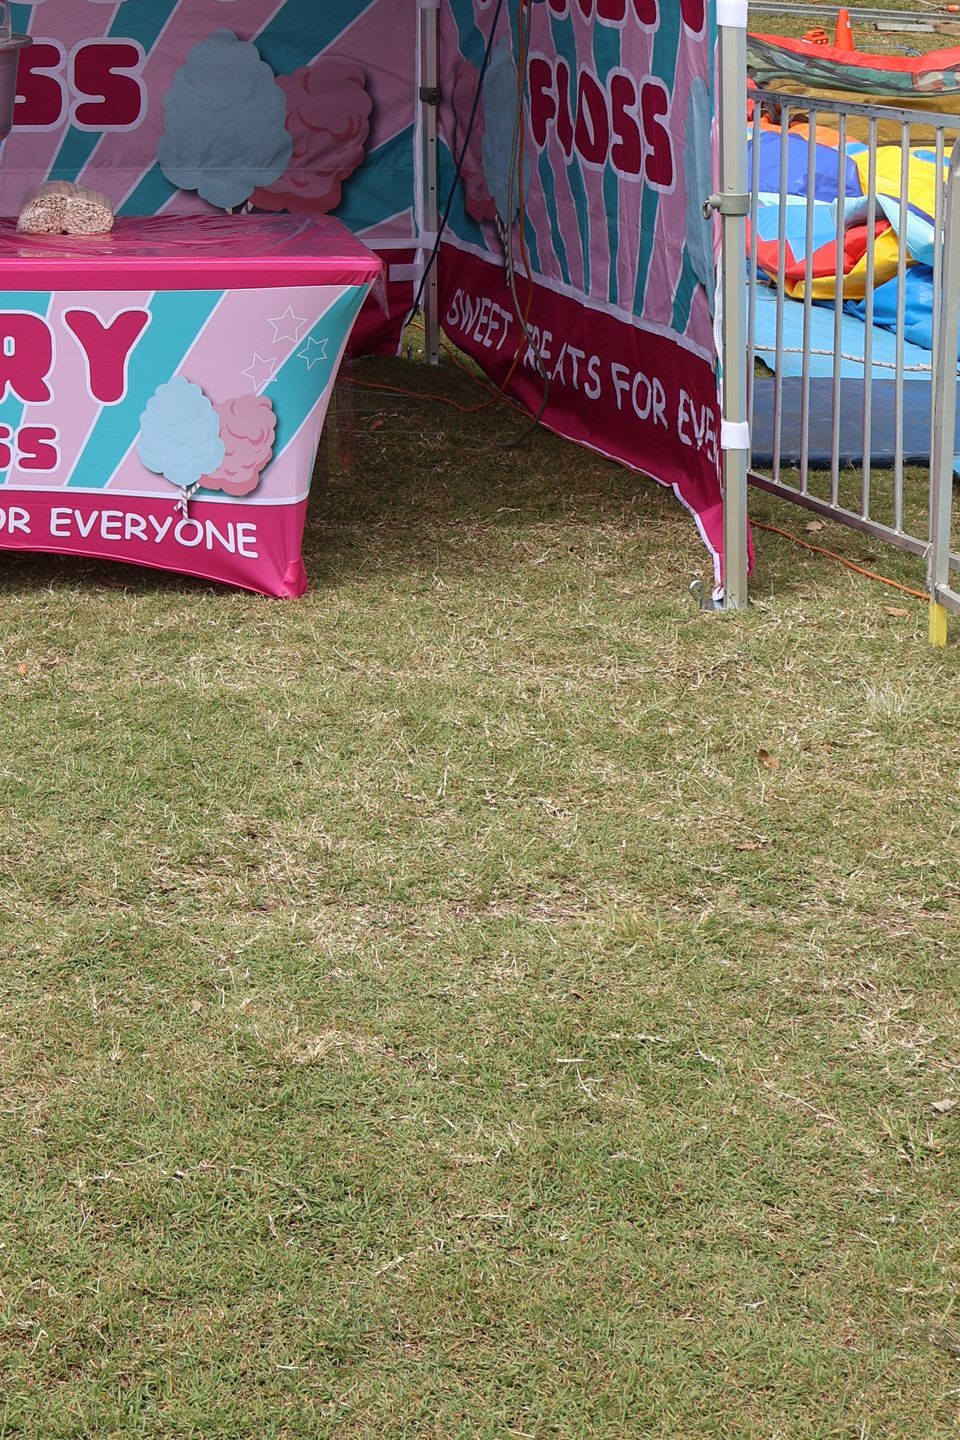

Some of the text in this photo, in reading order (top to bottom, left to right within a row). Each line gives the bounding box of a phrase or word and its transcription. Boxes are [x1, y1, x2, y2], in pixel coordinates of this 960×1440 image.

[527, 51, 677, 194] FLOSS
[446, 287, 514, 351] SWEET
[610, 361, 669, 430] FOR
[49, 507, 259, 559] EVERYONE
